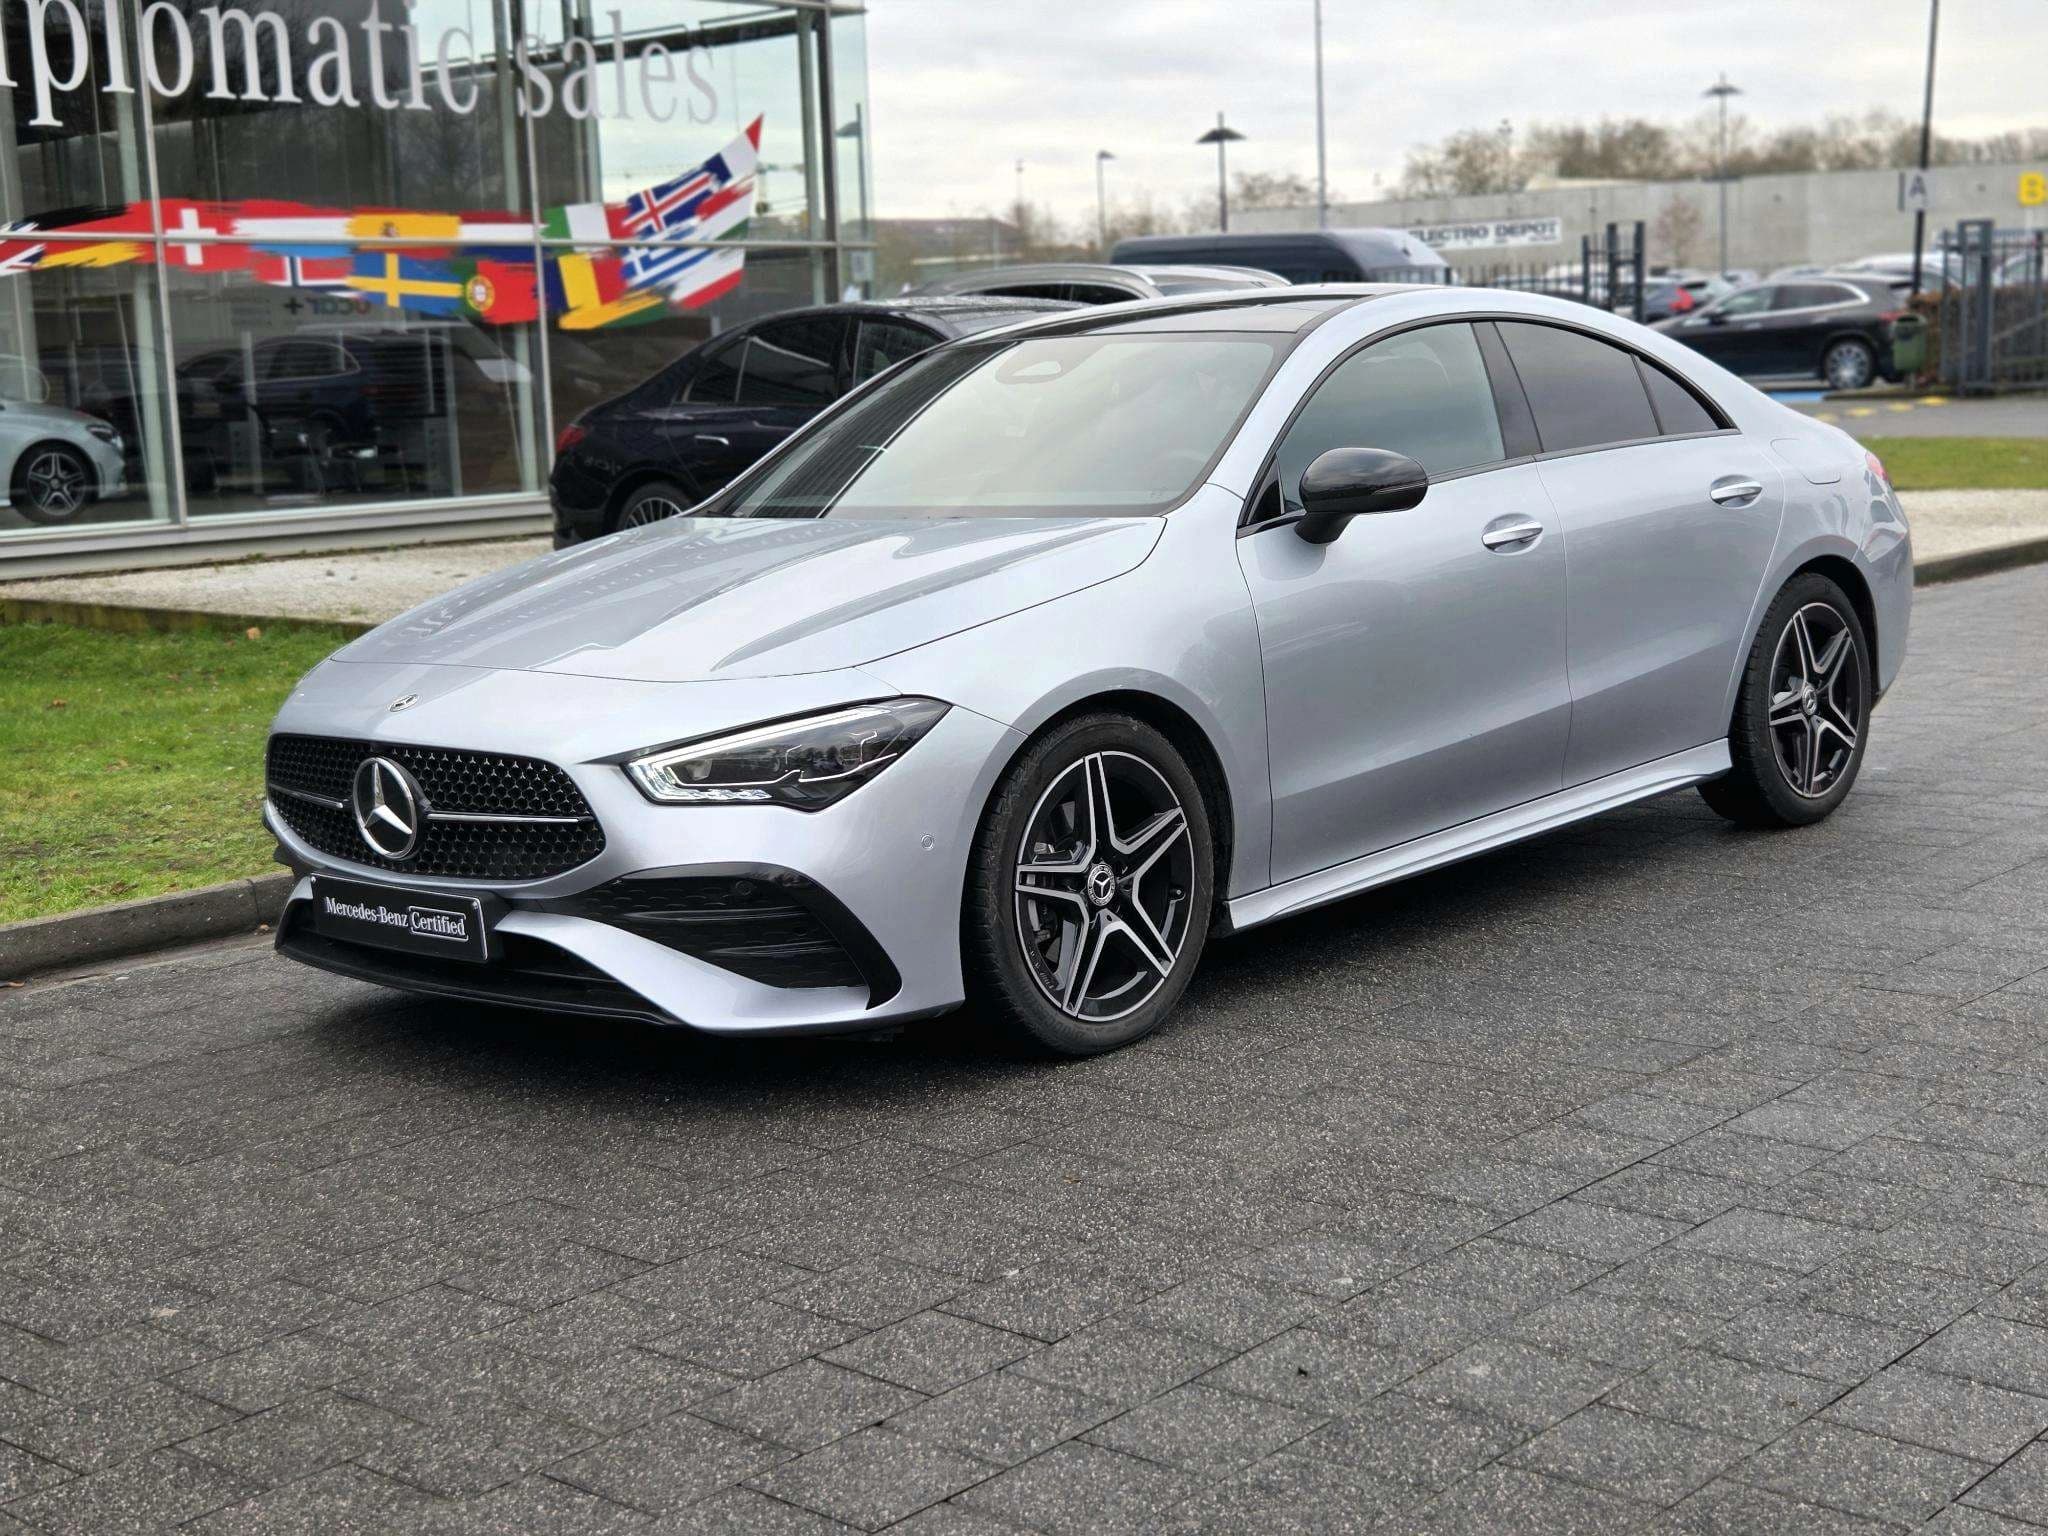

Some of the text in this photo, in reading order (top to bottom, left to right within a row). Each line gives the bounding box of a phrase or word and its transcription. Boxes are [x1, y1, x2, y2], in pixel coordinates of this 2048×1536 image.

[516, 10, 719, 124] sales
[1909, 174, 1927, 199] A
[1496, 221, 1556, 237] DEPOT
[325, 896, 466, 936] Mercedes-Benz Certified
